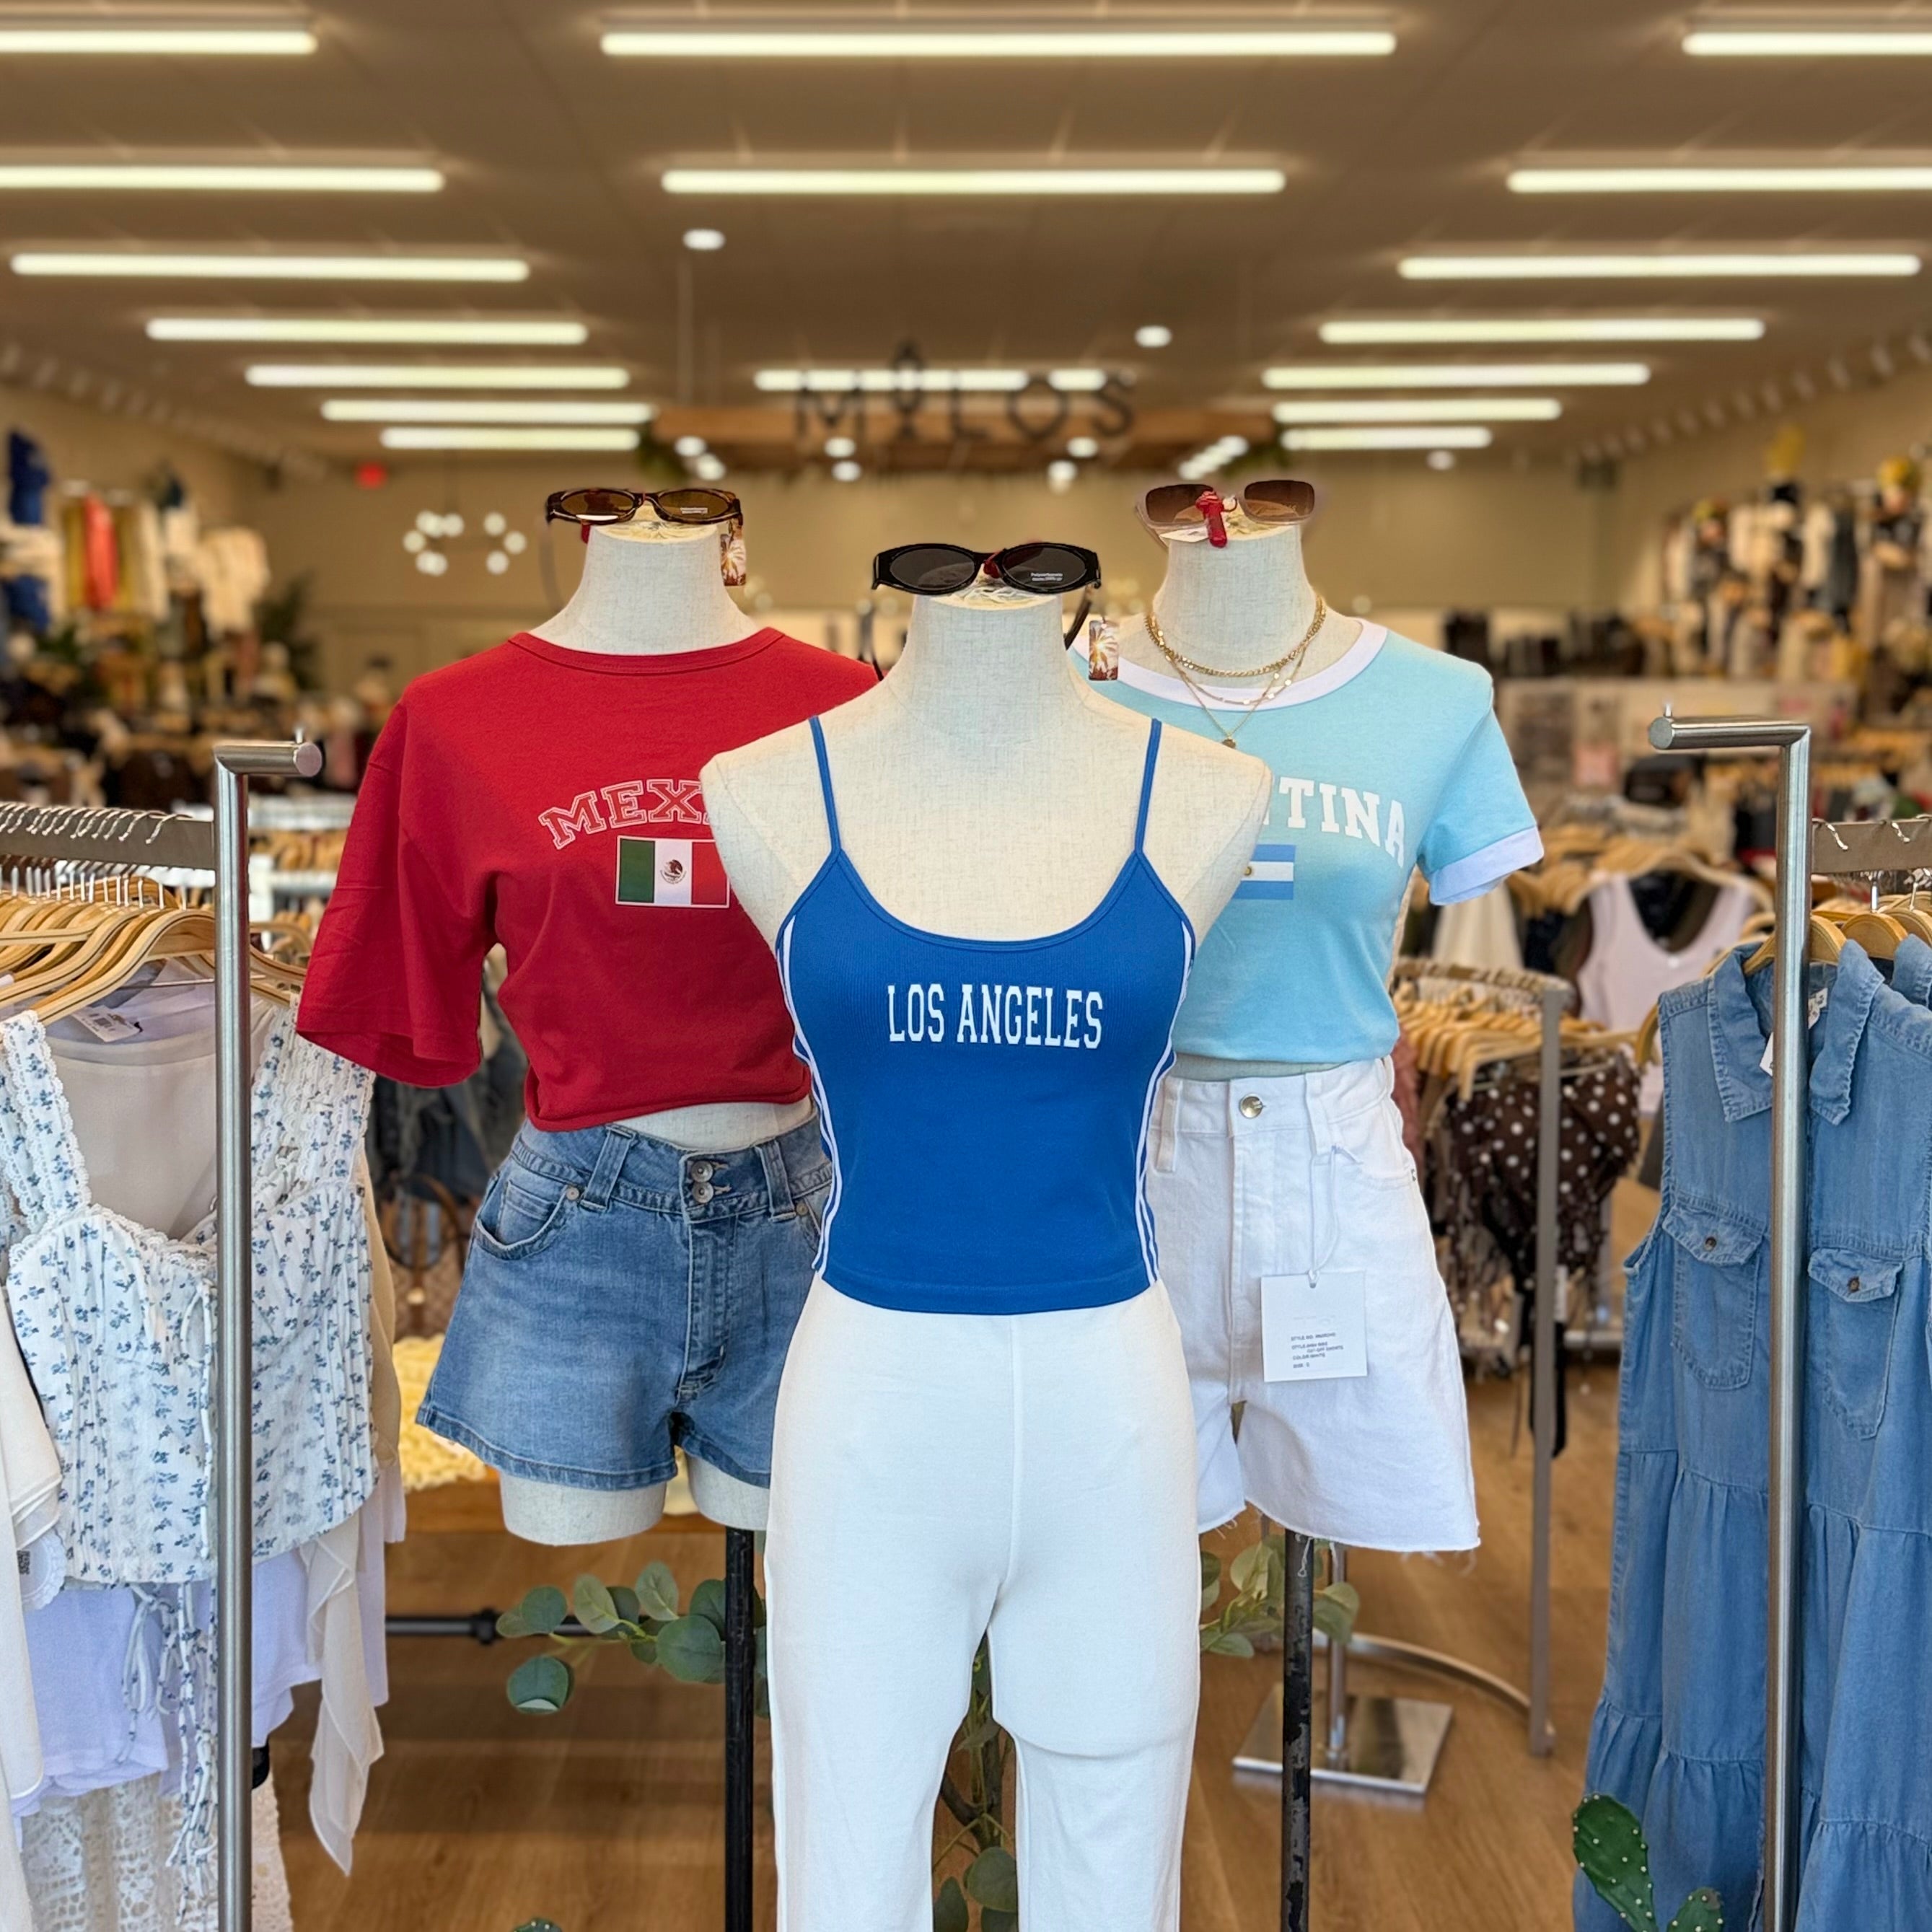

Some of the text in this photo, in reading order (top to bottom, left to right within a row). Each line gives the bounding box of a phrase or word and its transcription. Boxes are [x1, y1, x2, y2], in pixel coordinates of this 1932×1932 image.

[538, 779, 709, 850] MEX
[1263, 777, 1404, 867] TINA
[888, 983, 1103, 1049] LOS ANGELES
